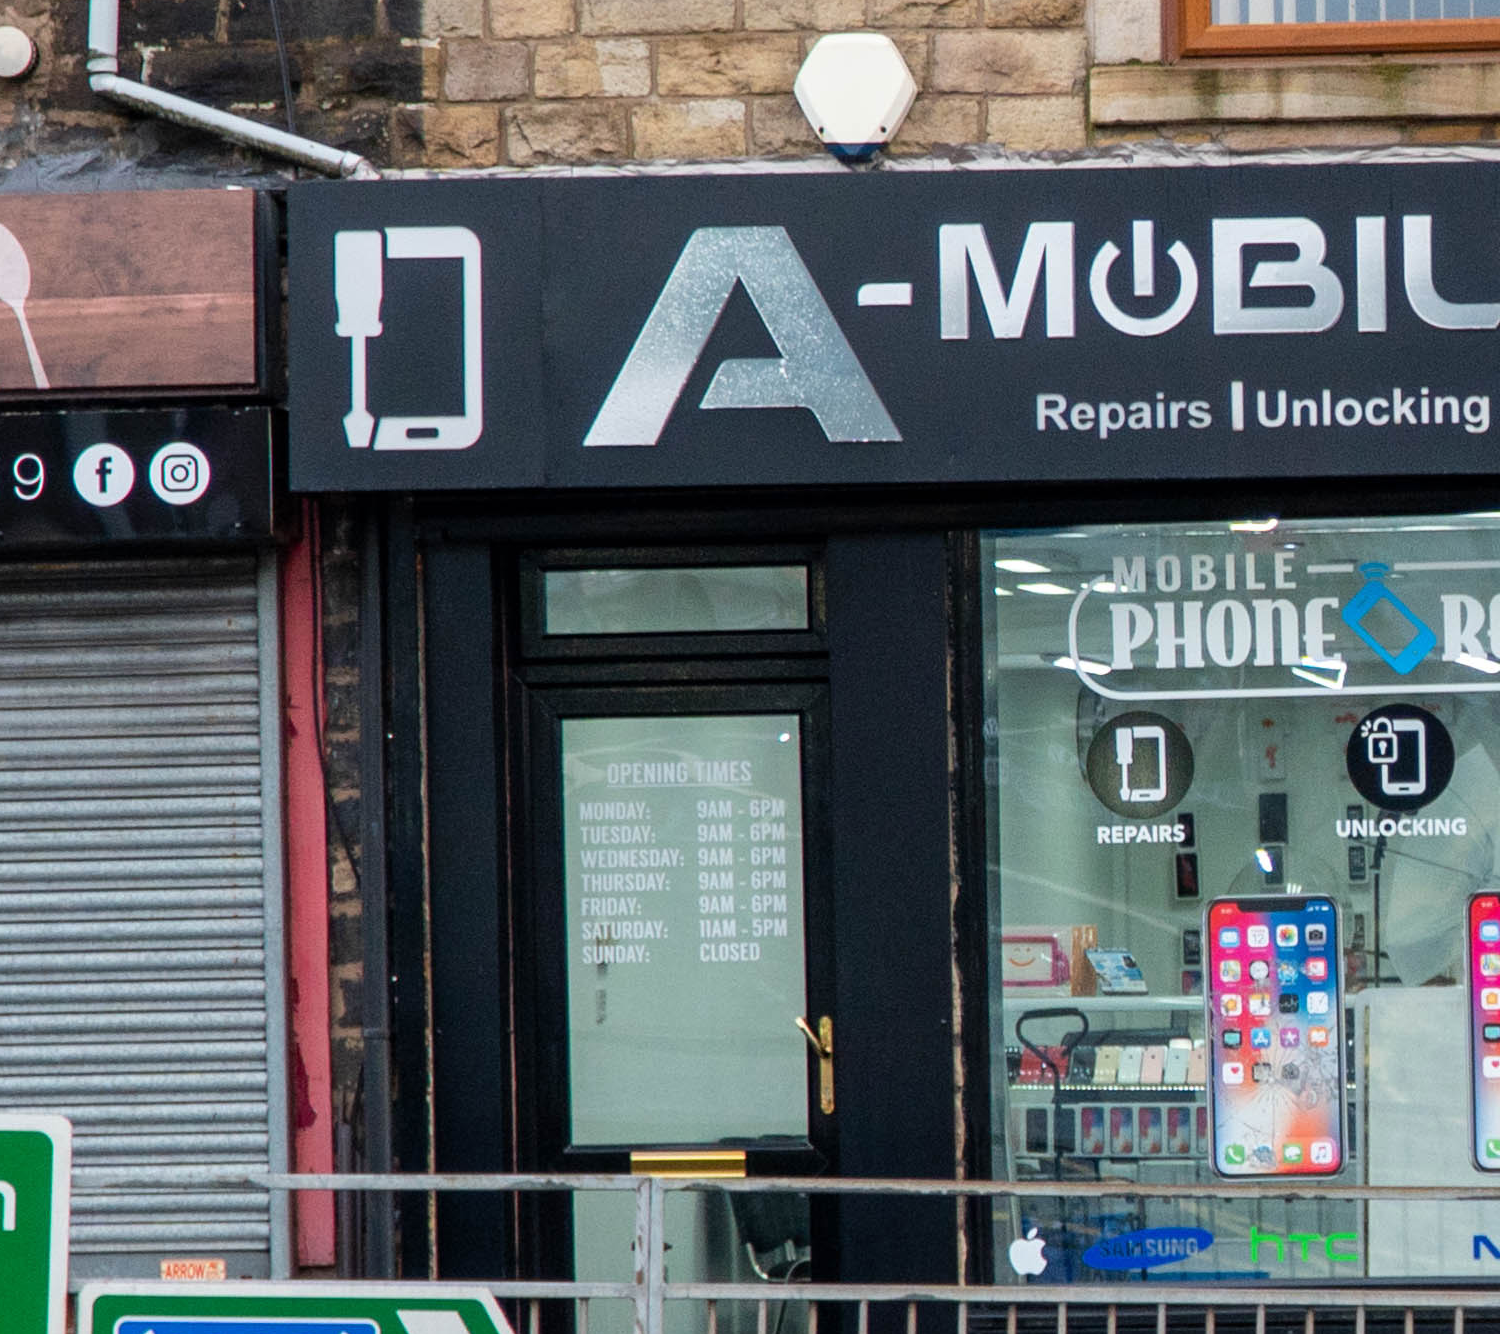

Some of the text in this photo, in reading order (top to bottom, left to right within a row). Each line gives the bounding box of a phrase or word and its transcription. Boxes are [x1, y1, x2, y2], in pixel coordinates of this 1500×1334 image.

[1037, 391, 1212, 438] Repairs
[1256, 389, 1490, 434] Unlocking
[1112, 551, 1298, 593] MOBILE
[1108, 595, 1343, 671] PHONE
[607, 761, 752, 785] OPENING TIMES
[579, 801, 651, 820] MONDAY:
[696, 800, 733, 818] 9AM
[749, 799, 785, 817] 6PM
[580, 825, 657, 844] TUESDAY:
[697, 823, 733, 842] 9AM
[749, 822, 786, 841] 6PM
[1096, 824, 1187, 844] REPAIRS
[1335, 816, 1467, 839] UNLOCKING
[580, 847, 685, 868] WEDNESDAY:
[698, 847, 733, 866] 9AM
[750, 846, 786, 865] 6PM
[581, 872, 671, 892] THURSDAY:
[698, 871, 734, 890] 9AM
[751, 870, 787, 889] 6PM
[581, 896, 642, 916] FRIDAY:
[699, 895, 735, 914] 9AM
[751, 894, 788, 913] 6PM
[581, 920, 669, 940] SATURDAY:
[699, 919, 736, 938] 11AM
[752, 918, 788, 937] 5PM
[582, 942, 761, 964] SUNDAY: CLOSED
[1099, 1237, 1199, 1259] SAMSUNG
[164, 1262, 205, 1280] ARROW
